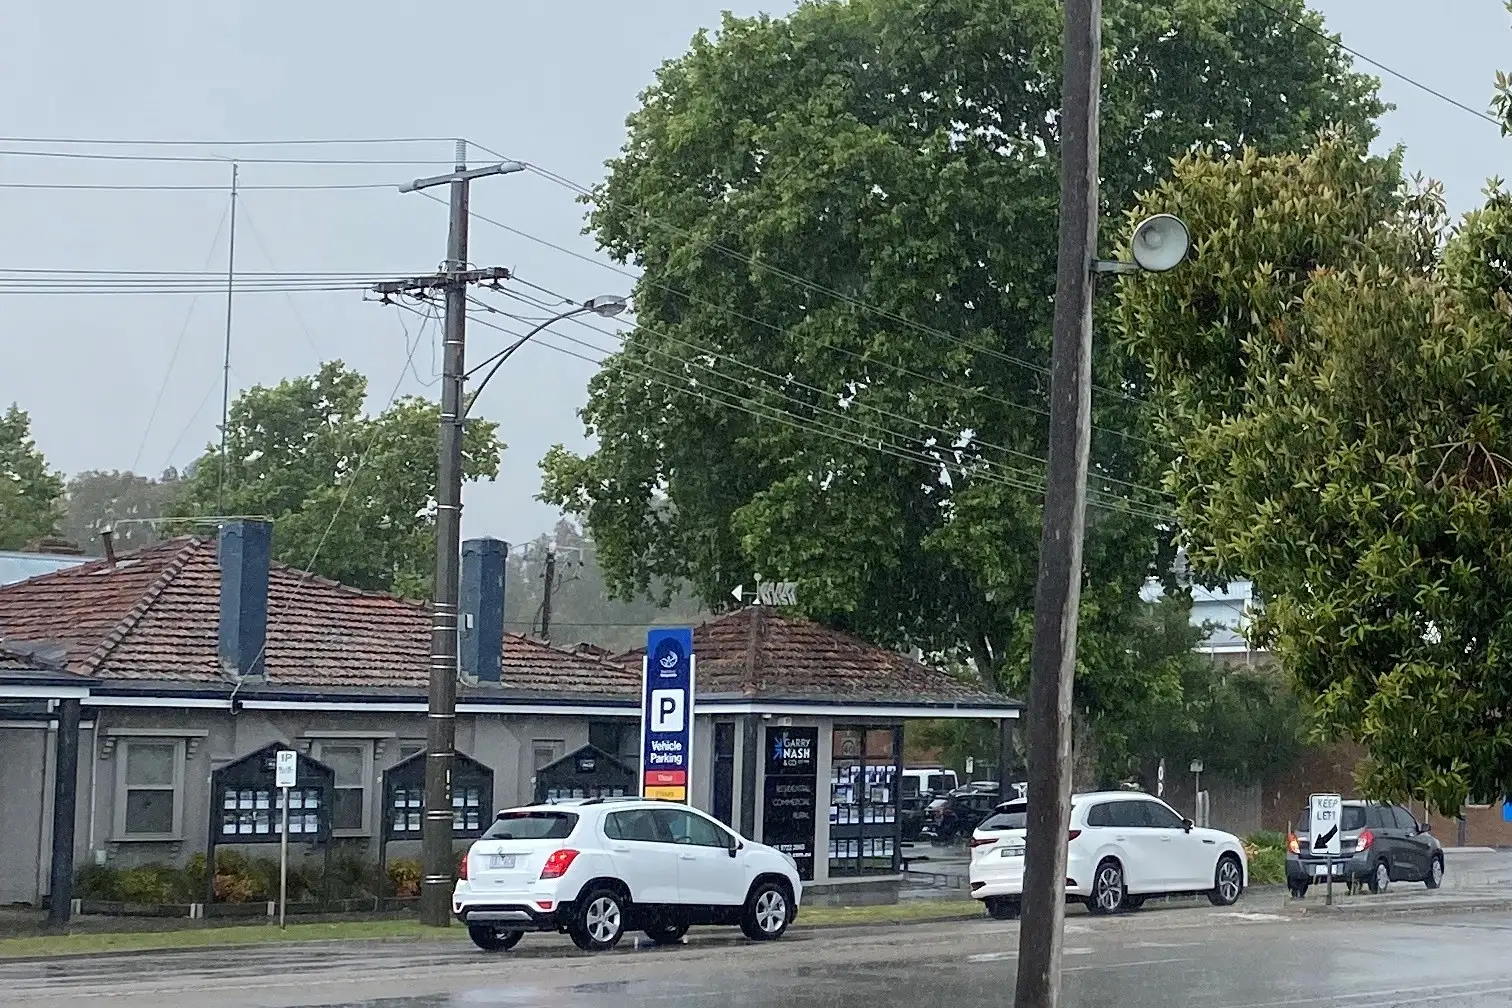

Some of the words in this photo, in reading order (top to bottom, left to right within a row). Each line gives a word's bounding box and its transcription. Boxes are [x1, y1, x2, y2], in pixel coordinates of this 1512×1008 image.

[660, 697, 676, 725] P
[651, 740, 682, 752] Vehicle
[783, 738, 811, 748] GARRY
[783, 748, 811, 759] NASH
[650, 753, 683, 766] Parking
[1317, 798, 1338, 809] KEEP
[1316, 810, 1336, 821] LEFT
